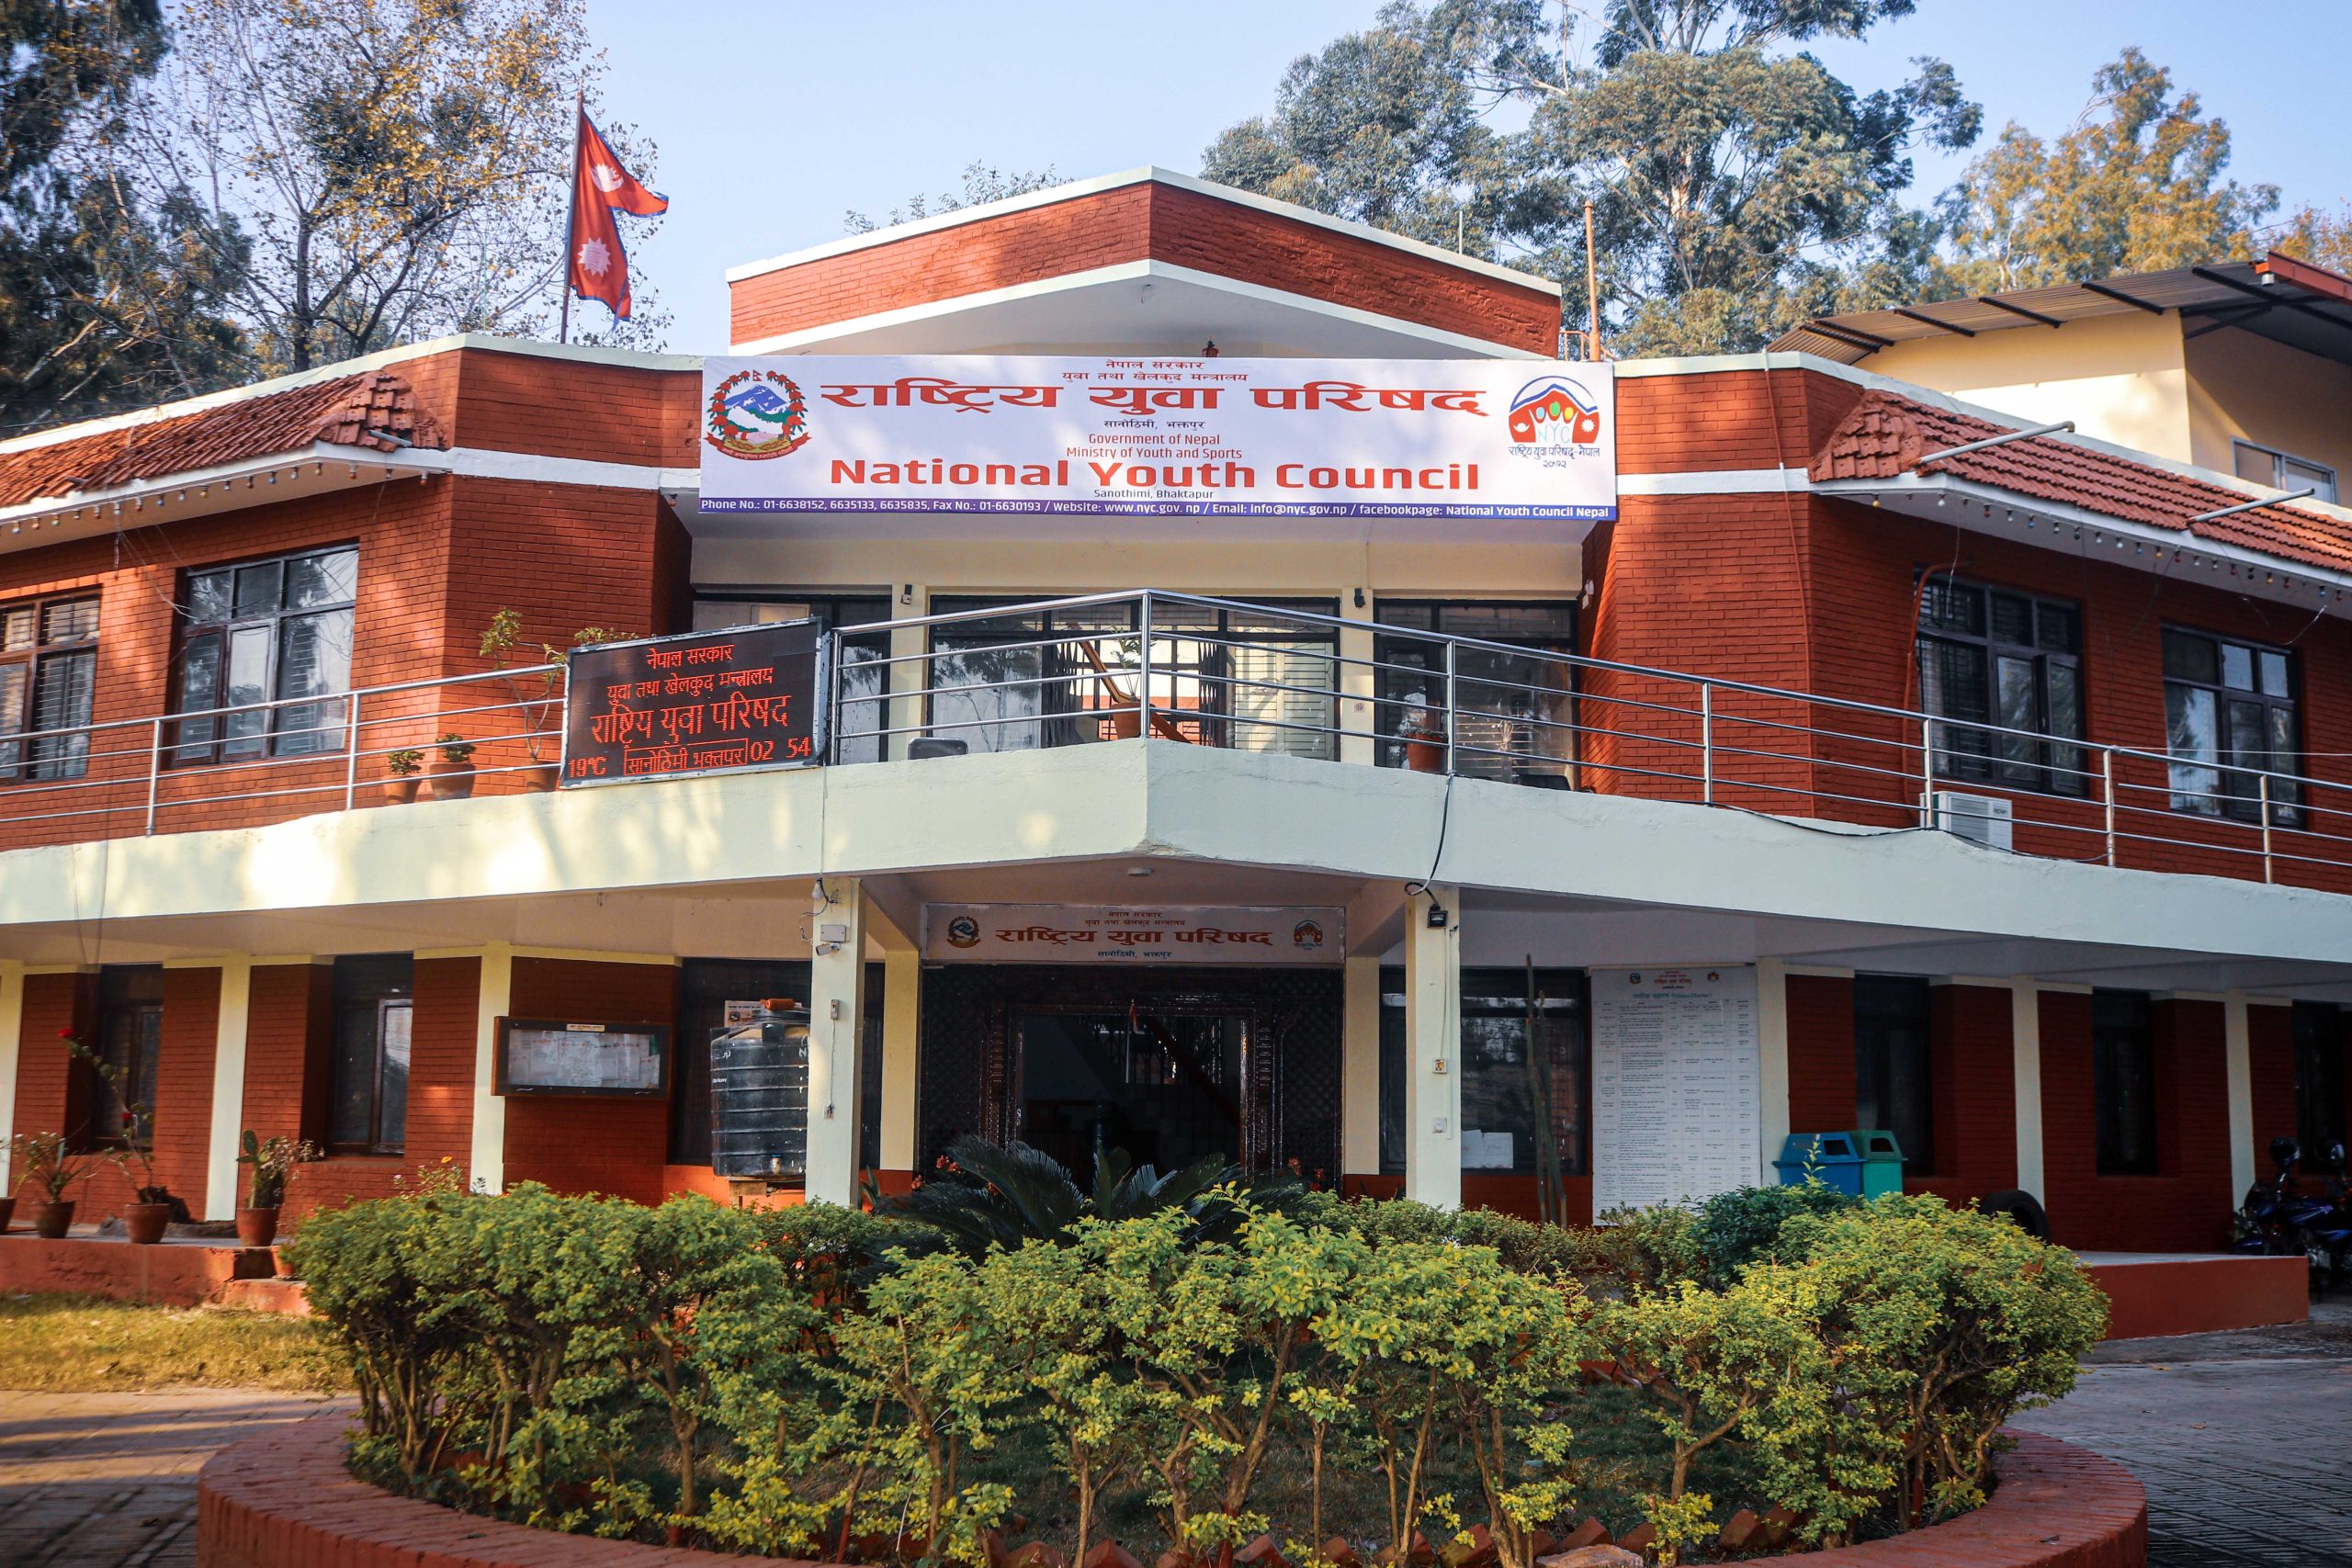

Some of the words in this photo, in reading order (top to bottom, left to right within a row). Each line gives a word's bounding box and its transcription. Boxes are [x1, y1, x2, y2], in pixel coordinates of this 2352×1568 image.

[1106, 359, 1144, 368] नेपाल
[1152, 361, 1204, 370] सरकार
[1062, 372, 1090, 382] युवा
[1098, 373, 1124, 381] तथा
[1133, 372, 1182, 384] खेलकुद
[1191, 373, 1249, 382] मन्त्रालय
[820, 377, 1064, 413] राष्ट्रिय
[1088, 387, 1225, 415] युवा
[1250, 380, 1489, 417] परिषद
[1089, 433, 1165, 446] Government
[1169, 434, 1182, 446] of
[1185, 434, 1220, 447] Nepal
[1538, 423, 1570, 444] NYC
[1067, 446, 1116, 459] Ministry
[1120, 446, 1134, 458] of
[1136, 446, 1172, 458] Youth
[1175, 447, 1199, 458] and
[1203, 447, 1242, 460] Sports
[1533, 446, 1546, 459] युवा
[831, 458, 1069, 486] National
[1088, 461, 1255, 488] Youth
[1276, 463, 1478, 490] Council
[1094, 489, 1153, 499] Sanothimi,
[1156, 489, 1215, 501] Bhaktapur
[701, 500, 736, 510] Phone
[740, 500, 761, 510] No.:
[763, 500, 827, 511] 01-6638152,
[830, 500, 876, 512] 6635133,
[880, 501, 930, 512] 6635835,
[933, 500, 952, 510] Fax
[955, 501, 976, 511] No.:
[979, 501, 1041, 512] 01-6630193
[1044, 502, 1050, 513] /
[1053, 502, 1101, 513] Website:
[1203, 502, 1209, 514] /
[1213, 503, 1247, 513] Email:
[1250, 504, 1346, 516] info@nyc.gov.np
[1351, 504, 1356, 516] /
[1360, 504, 1442, 517] facebookpage:
[1446, 505, 1493, 515] National
[1497, 506, 1529, 516] Youth
[1532, 506, 1573, 517] Council
[1576, 507, 1608, 519] Nepal
[646, 648, 684, 669] नेपाल
[684, 644, 735, 665] सरकार
[606, 683, 632, 705] युवा
[636, 681, 661, 698] तथा
[664, 672, 715, 697] खेलकुद
[661, 705, 705, 744] युवा
[709, 691, 792, 731] परिषद
[751, 739, 775, 761] 02
[786, 737, 811, 759] 54
[995, 926, 1098, 945] राष्ट्रिय
[1107, 931, 1164, 946] युवा
[1174, 927, 1274, 946] परिषद
